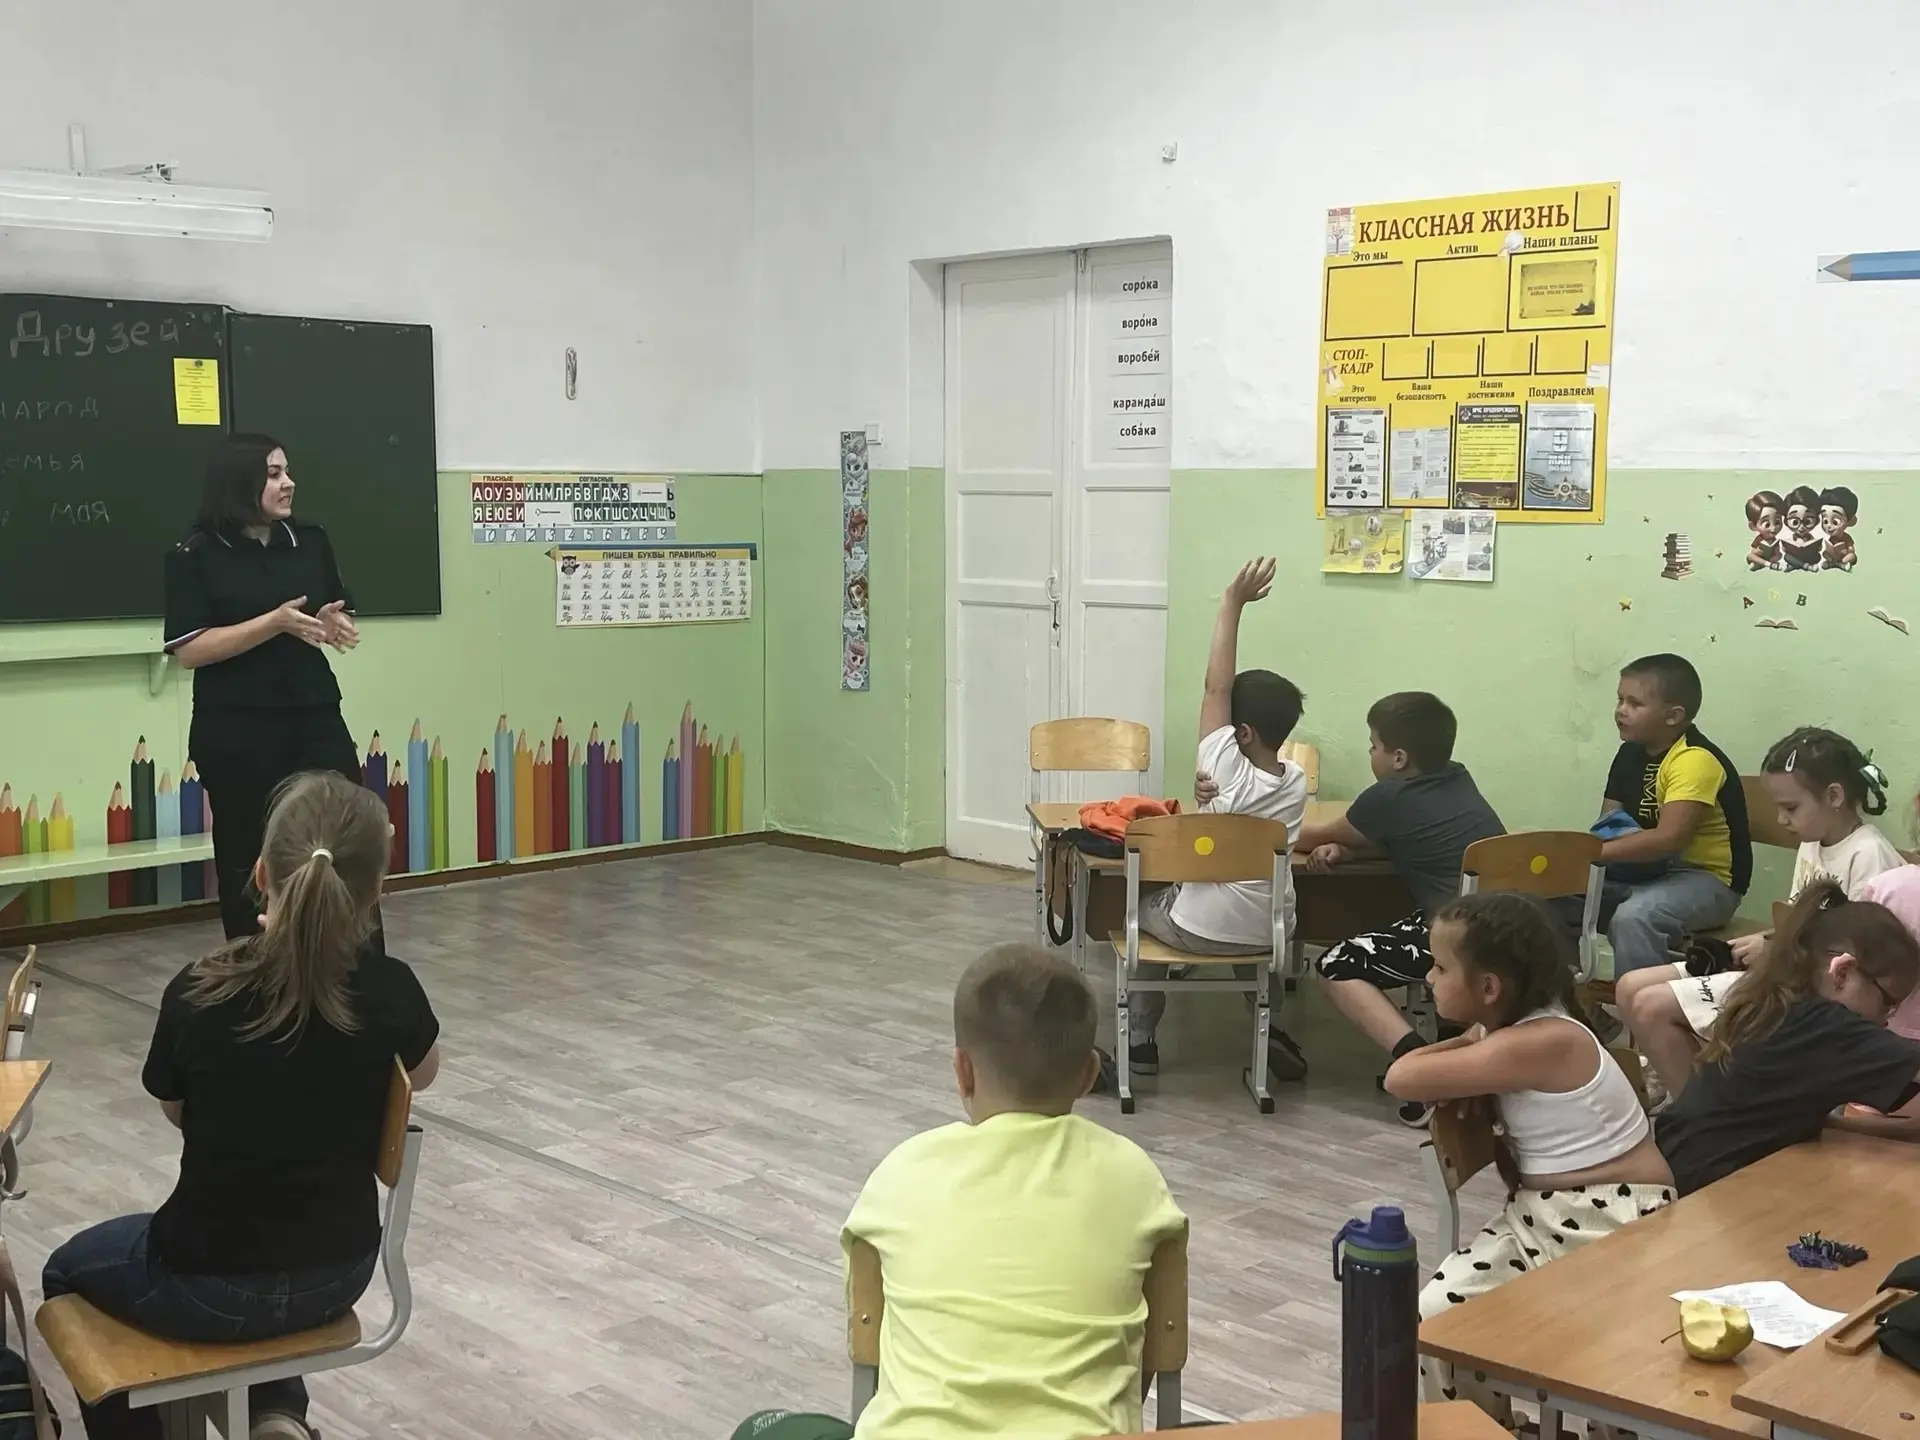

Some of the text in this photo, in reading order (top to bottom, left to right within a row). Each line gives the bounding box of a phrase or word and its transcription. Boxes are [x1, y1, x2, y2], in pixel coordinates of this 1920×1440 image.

[1359, 204, 1571, 244] КЛАССНАЯ ЖИЗНЬ
[1523, 234, 1598, 249] Наши планы
[1446, 243, 1479, 255] Актив
[1353, 250, 1388, 262] Это мы
[9, 309, 180, 359] Друзей
[1333, 348, 1369, 361] СТОП-
[1340, 362, 1374, 375] КАДР
[1352, 384, 1365, 393] Это
[1480, 380, 1503, 389] Наши
[1396, 391, 1447, 402] безопасность
[1467, 389, 1515, 400] достижения
[1528, 386, 1595, 399] Поздравляем
[1339, 394, 1377, 404] интересно
[602, 550, 717, 559] ПИШЕМ БУКВЫ ПРАВИЛЬНО
